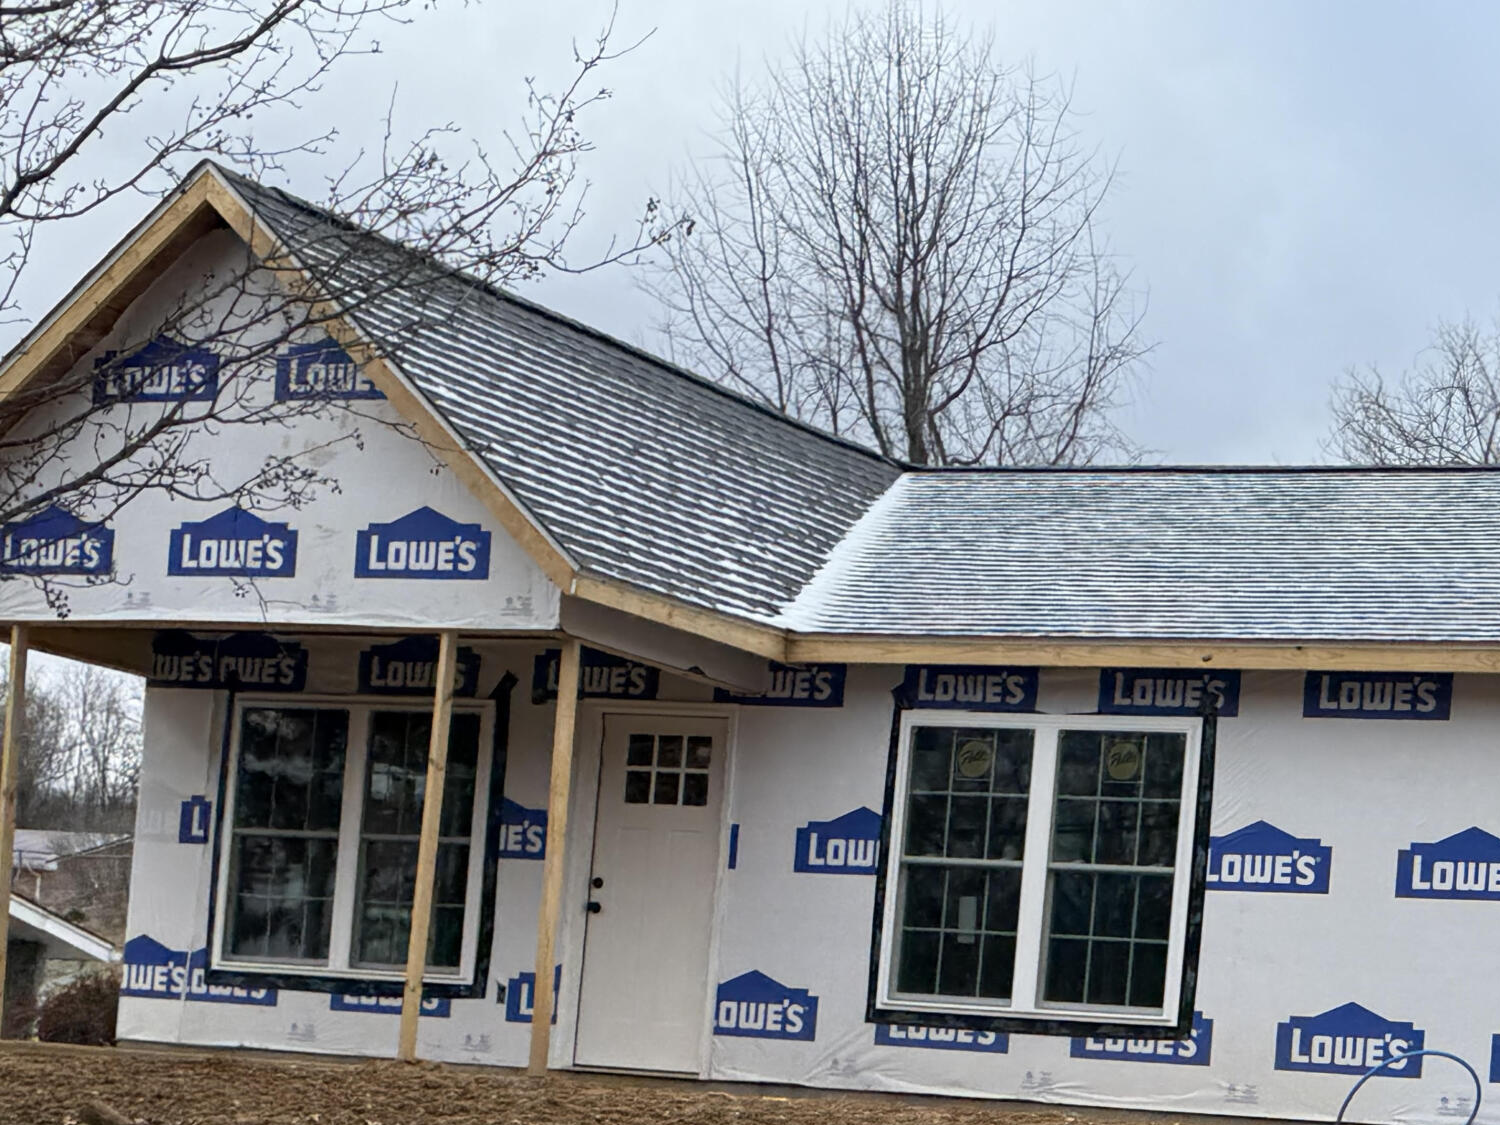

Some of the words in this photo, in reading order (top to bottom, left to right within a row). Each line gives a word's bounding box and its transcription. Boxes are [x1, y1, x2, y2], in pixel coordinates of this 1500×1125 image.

[288, 358, 374, 393] LOWE
[181, 533, 284, 570] LOWE'S
[369, 535, 477, 572] LOWE'S
[766, 666, 832, 700] WE'S
[917, 669, 1025, 704] LOWE'S
[1114, 672, 1225, 708] LOWE'S
[1319, 675, 1437, 713] LOWE'S
[718, 999, 804, 1033] OWE'S
[1290, 1028, 1409, 1070] LOWE'S
